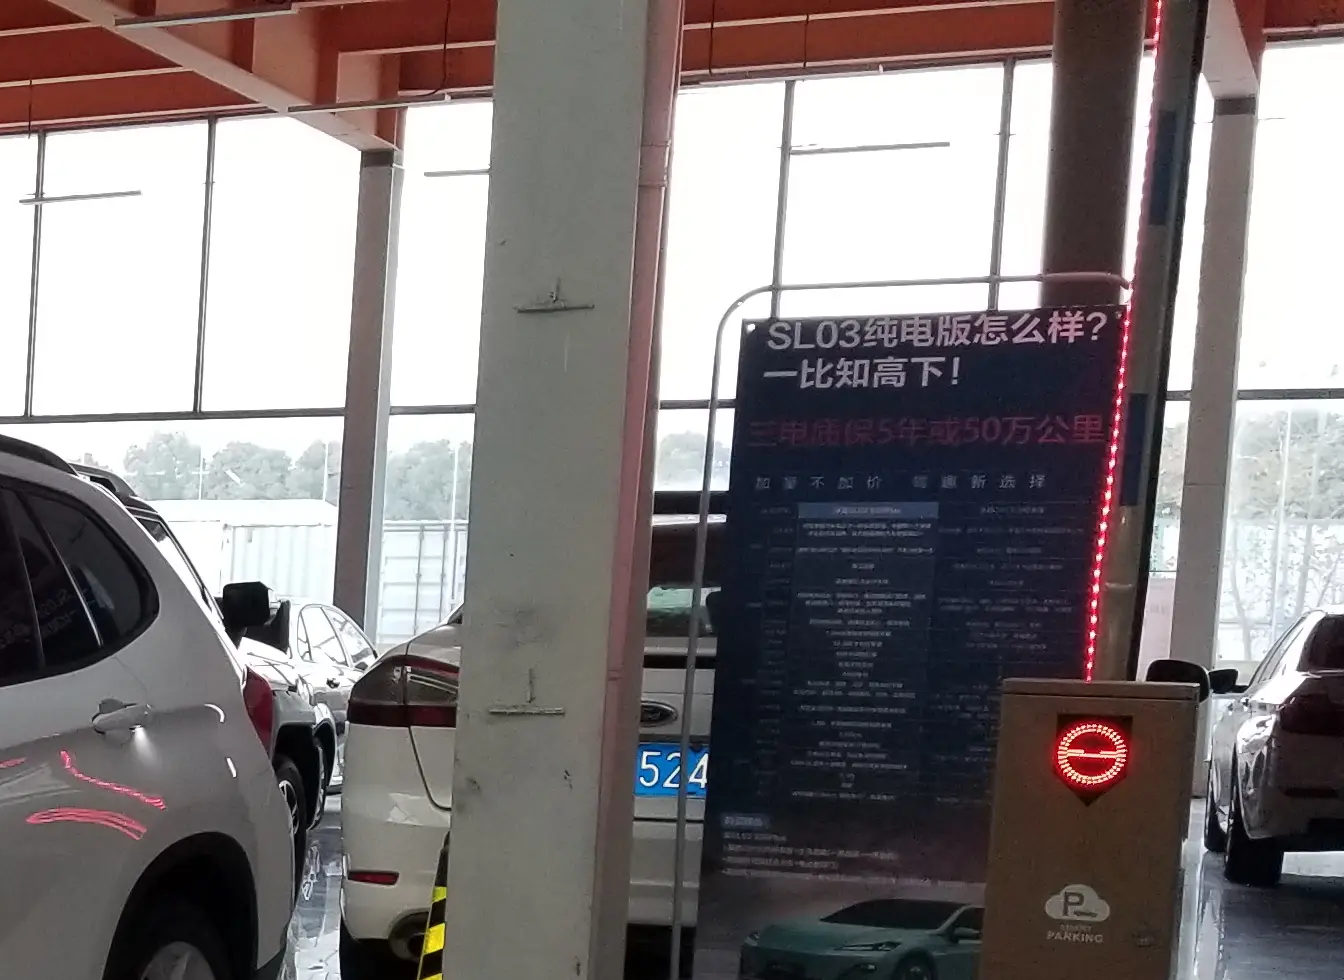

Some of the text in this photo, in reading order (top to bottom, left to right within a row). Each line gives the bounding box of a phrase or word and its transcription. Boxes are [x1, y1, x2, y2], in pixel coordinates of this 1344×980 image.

[767, 311, 1108, 351] SL03纯电版怎么样?
[763, 356, 961, 389] 一比知高下!
[1046, 930, 1104, 944] PARKING
